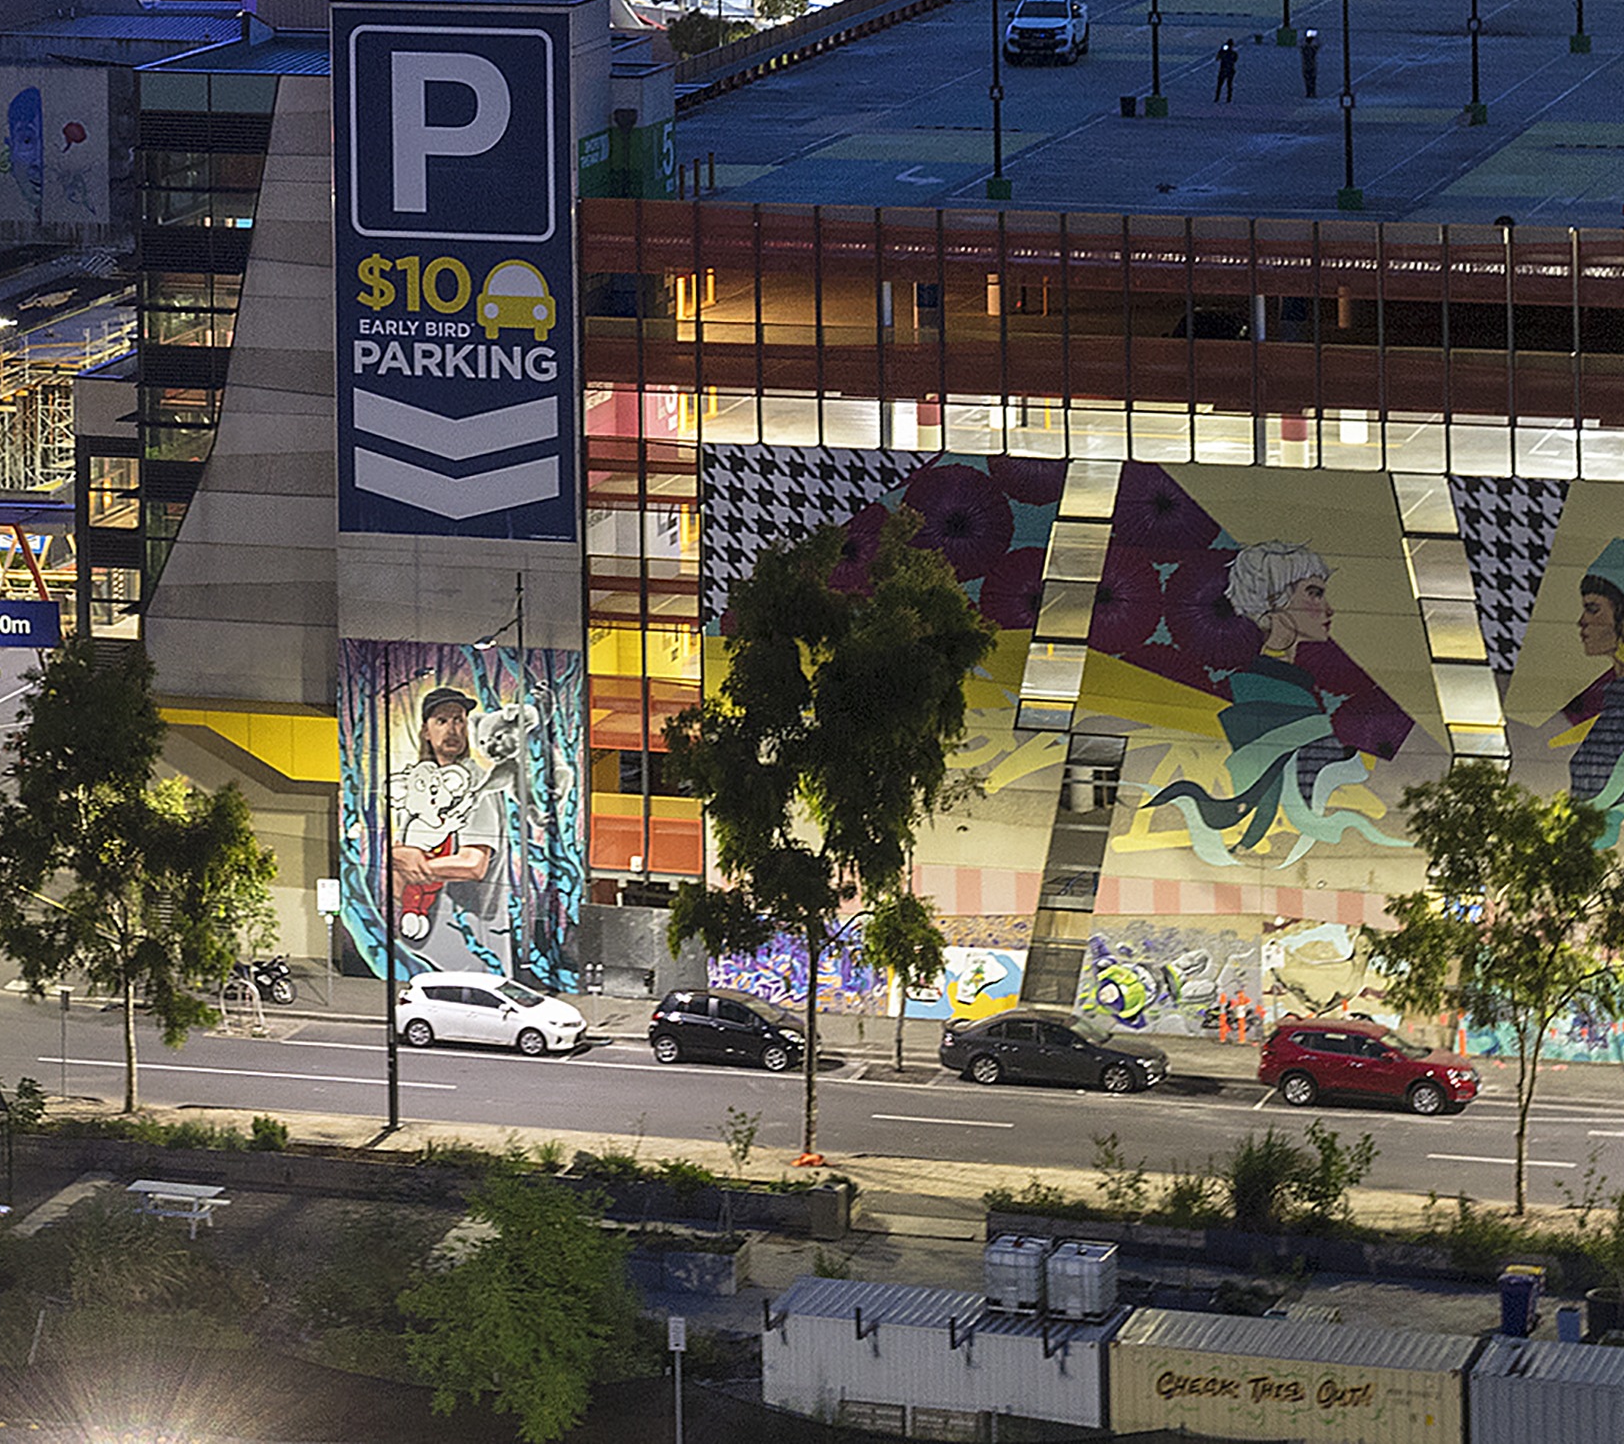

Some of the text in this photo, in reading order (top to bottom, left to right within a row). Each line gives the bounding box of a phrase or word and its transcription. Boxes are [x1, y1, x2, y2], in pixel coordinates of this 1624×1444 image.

[391, 50, 511, 213] P
[356, 253, 472, 314] $10
[359, 319, 420, 336] EARLY
[353, 340, 558, 382] PARKING
[1248, 1375, 1305, 1404] THIS
